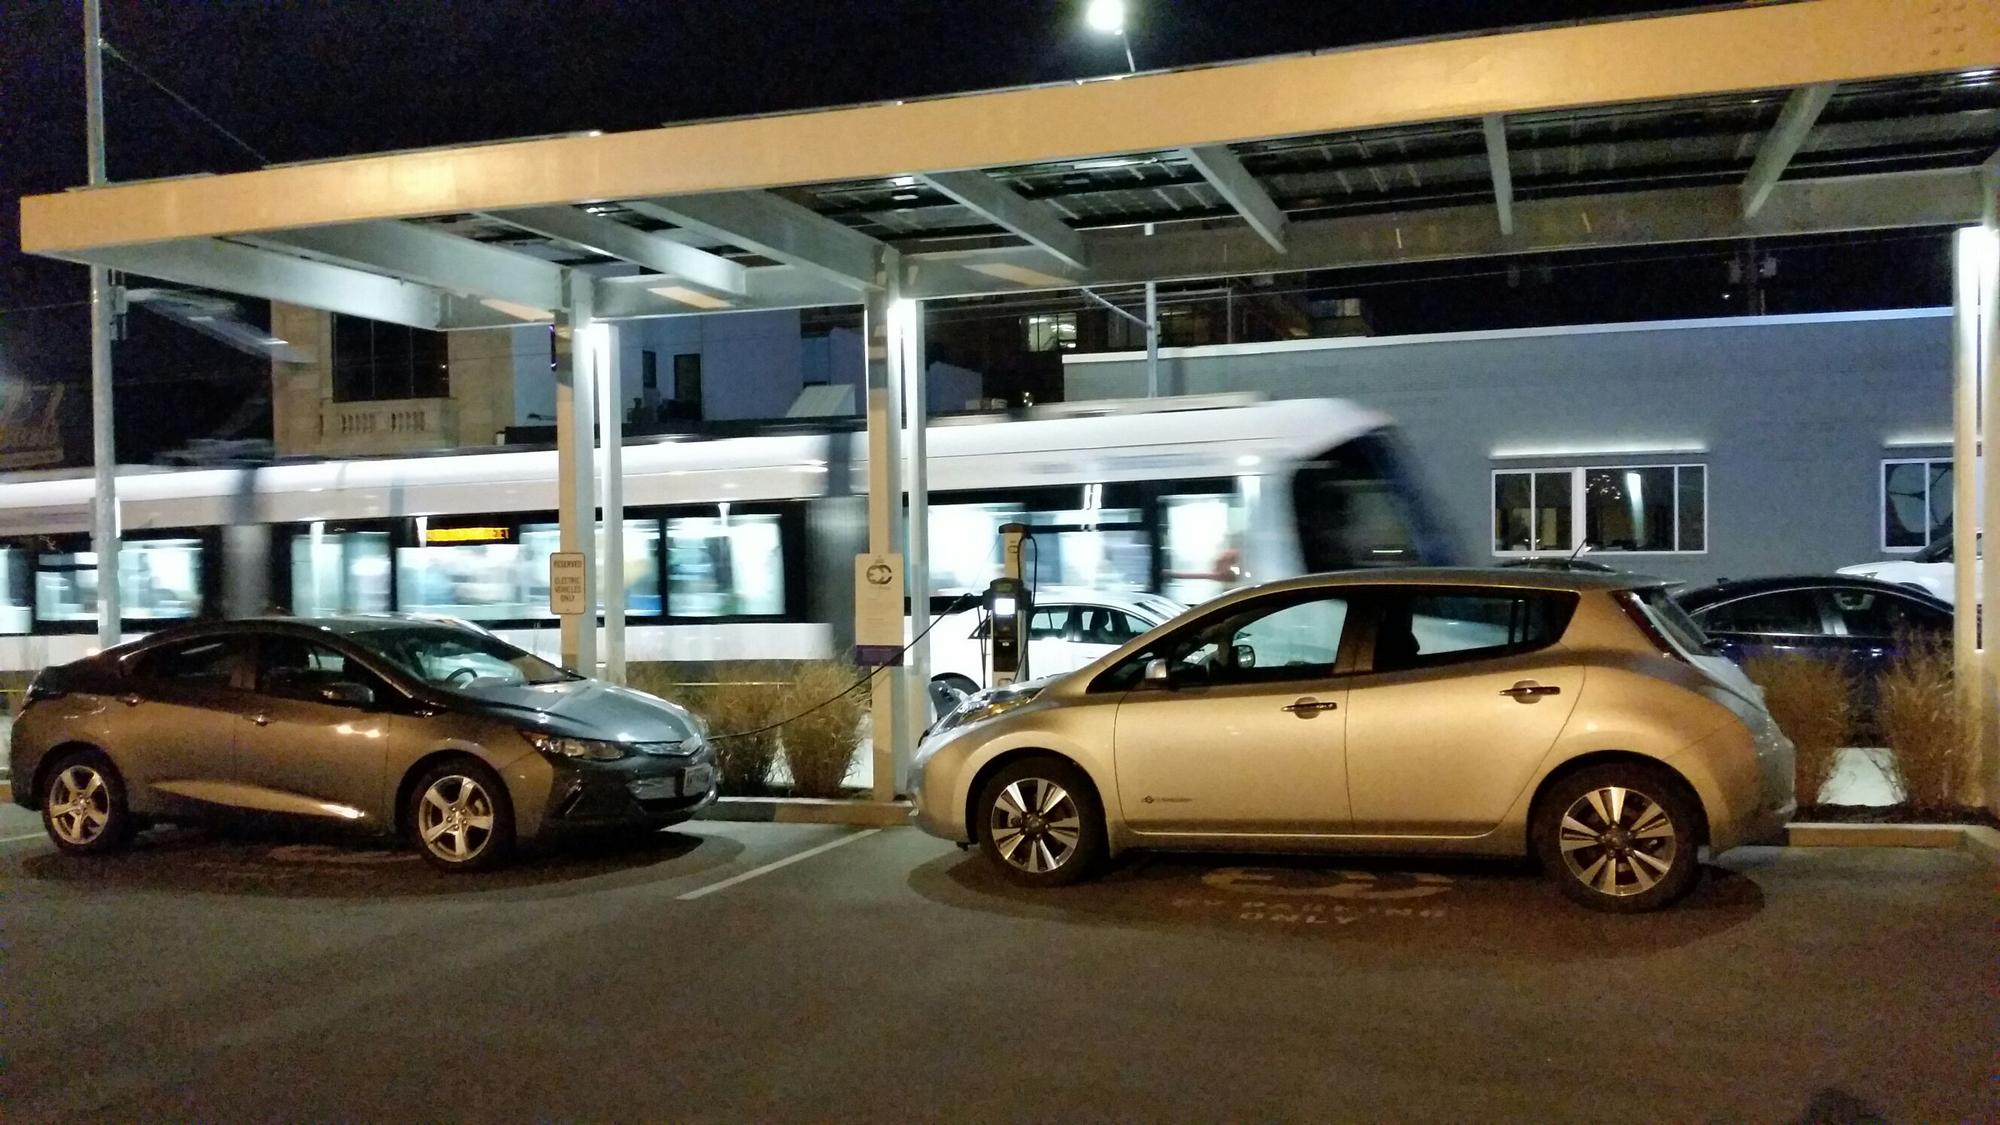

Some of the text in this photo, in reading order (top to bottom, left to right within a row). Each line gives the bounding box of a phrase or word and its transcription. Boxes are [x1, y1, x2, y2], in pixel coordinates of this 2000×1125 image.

[553, 560, 582, 568] RESERVED
[554, 585, 582, 593] VEHICLES
[560, 594, 575, 602] ONLY
[1240, 912, 1357, 924] ONLY
